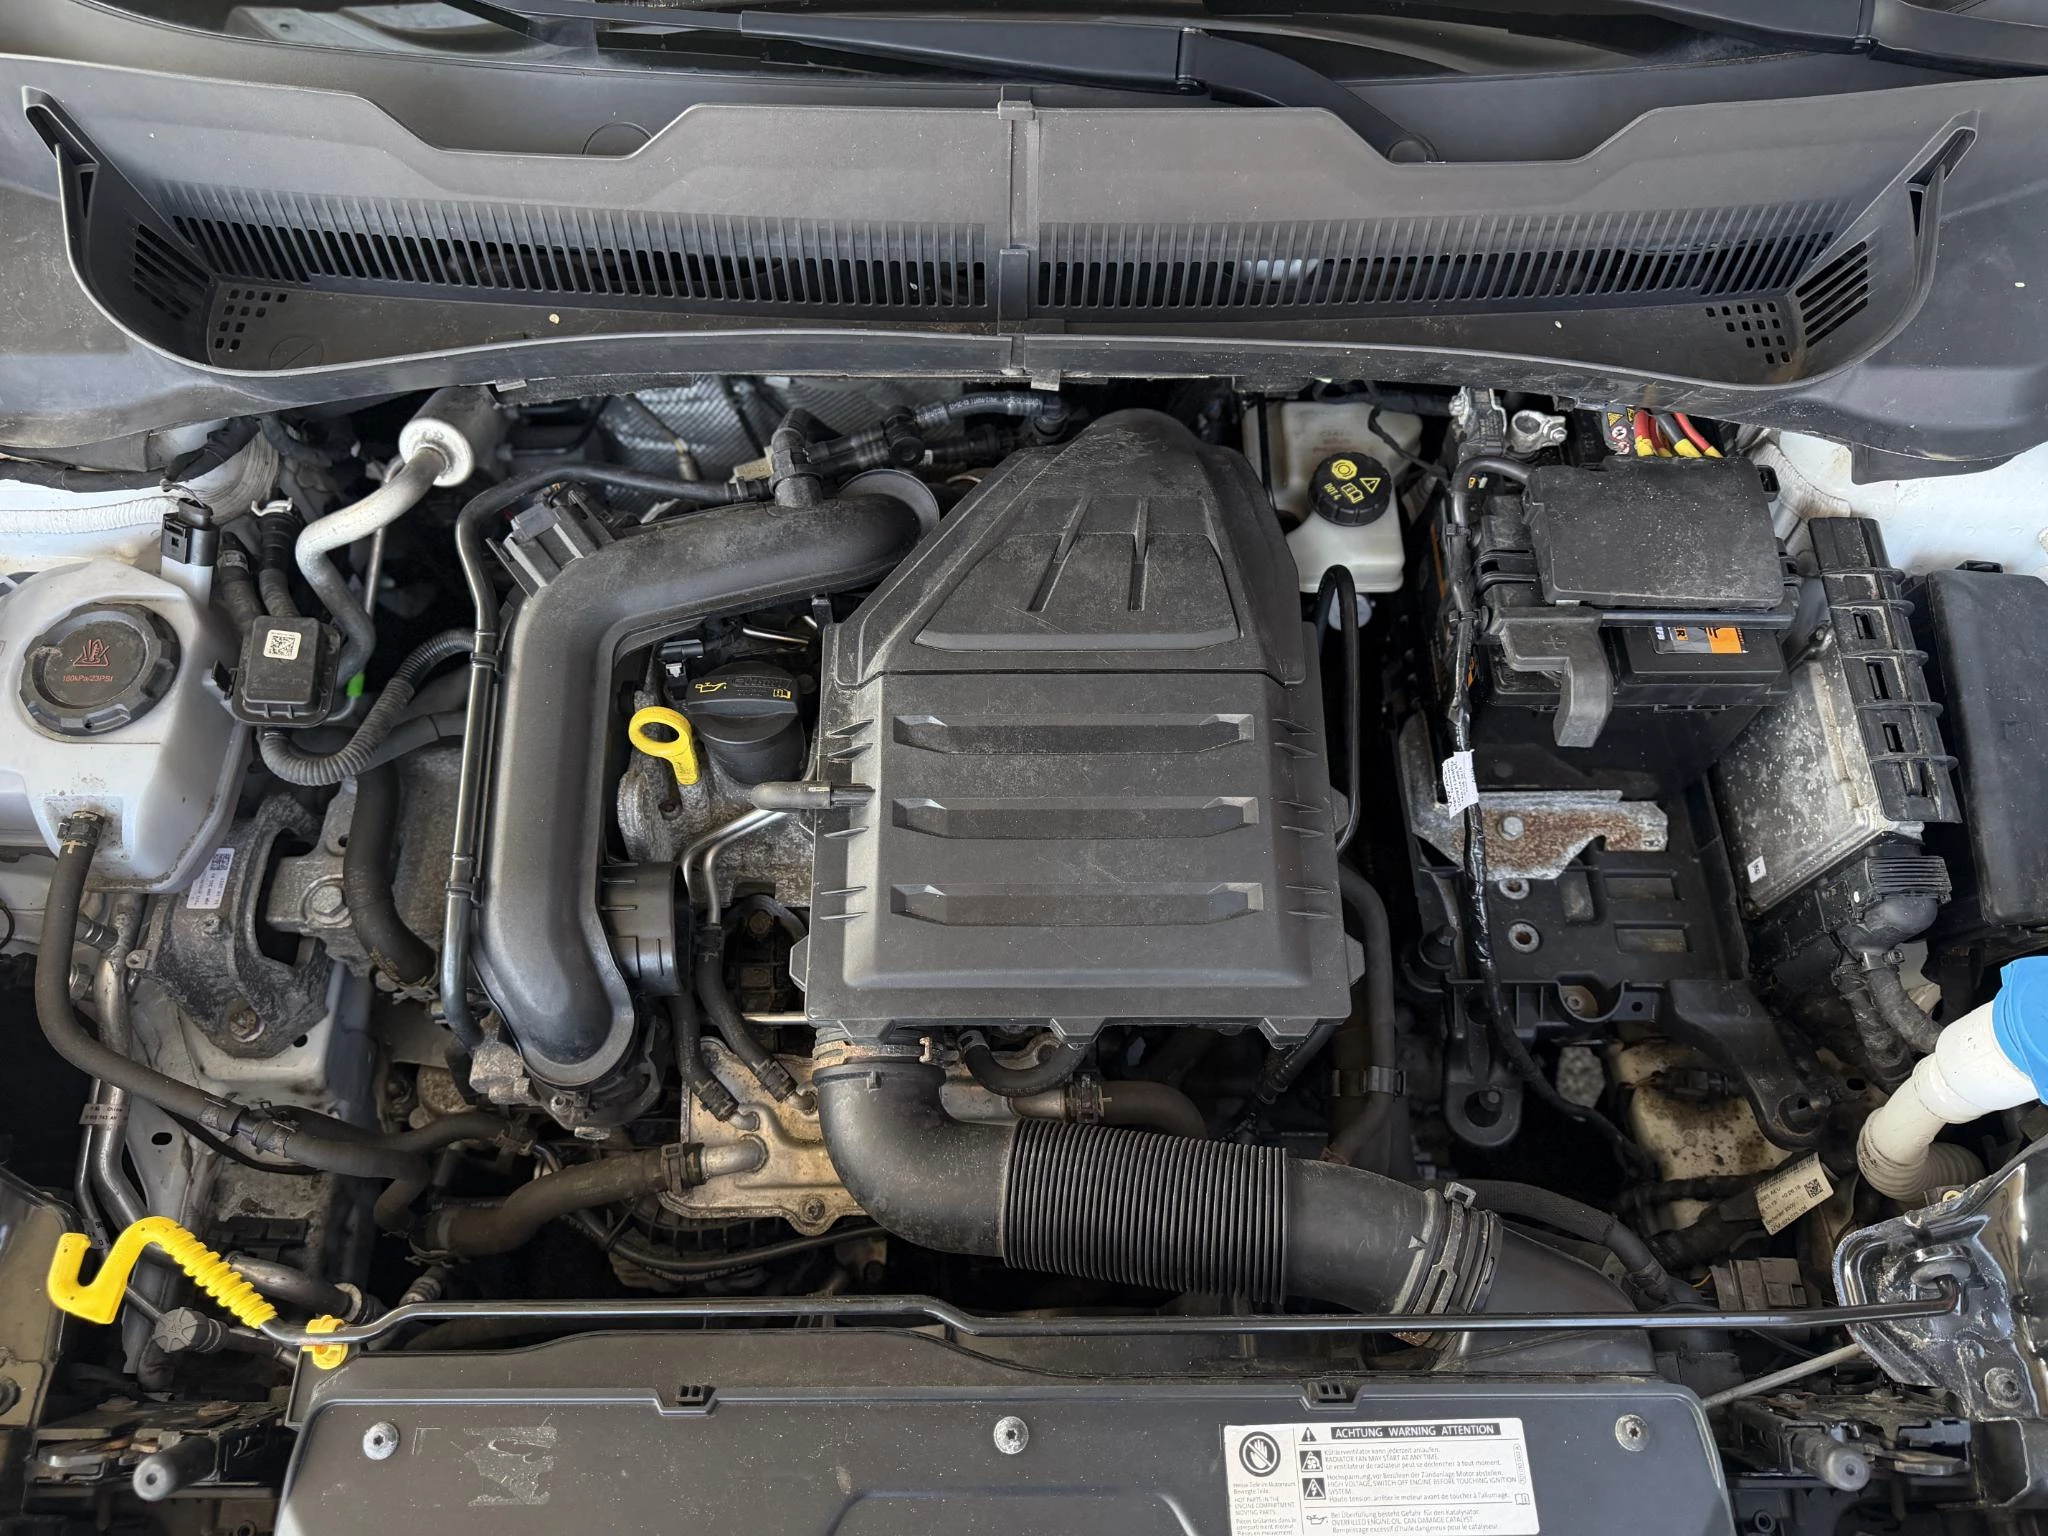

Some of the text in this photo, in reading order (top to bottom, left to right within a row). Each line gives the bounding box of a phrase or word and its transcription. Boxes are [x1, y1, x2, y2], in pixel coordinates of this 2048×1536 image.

[1324, 483, 1338, 496] DOT
[1335, 1424, 1494, 1438] ACHTUNG WARNING ATTENTION
